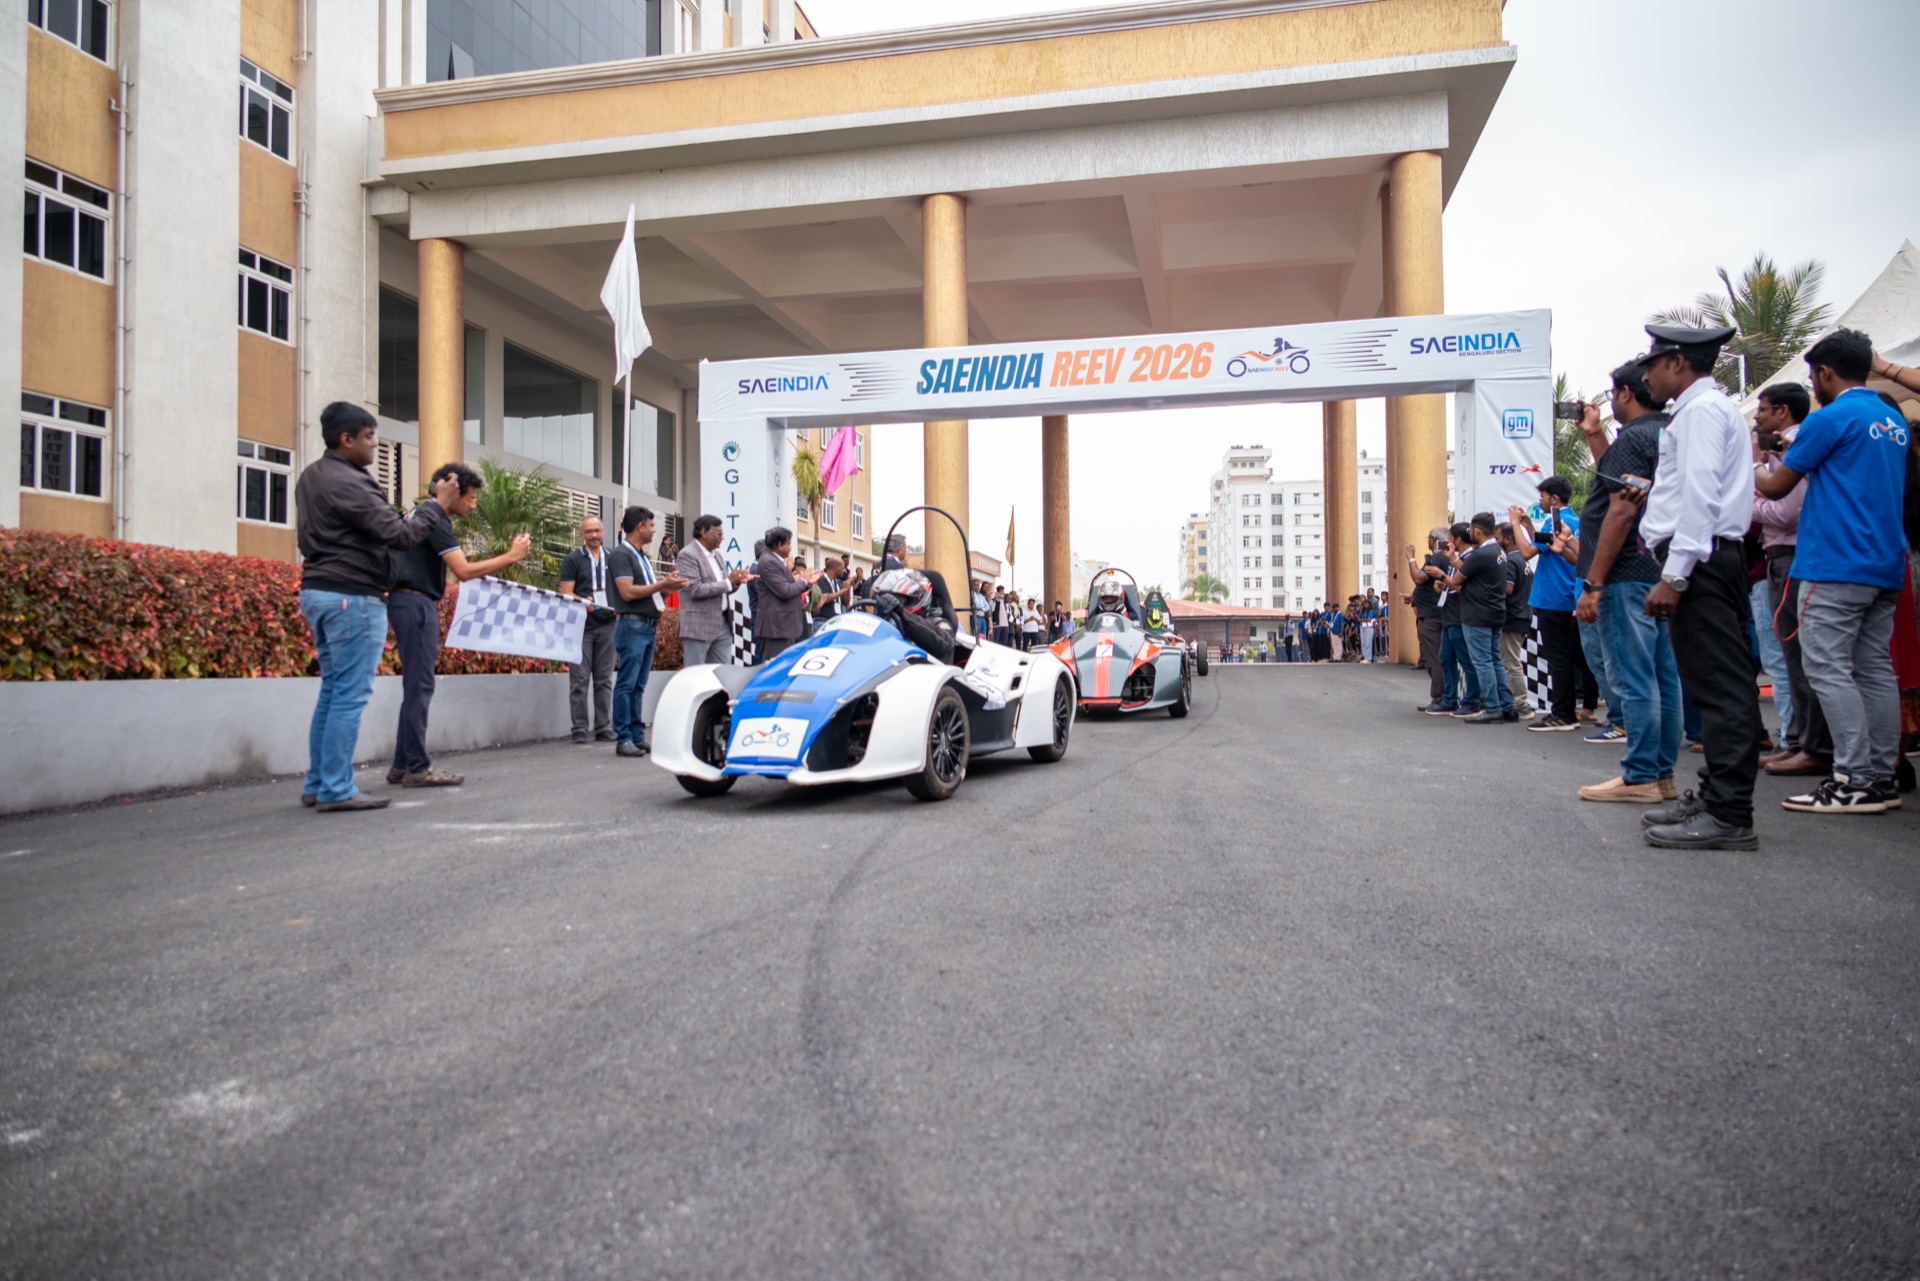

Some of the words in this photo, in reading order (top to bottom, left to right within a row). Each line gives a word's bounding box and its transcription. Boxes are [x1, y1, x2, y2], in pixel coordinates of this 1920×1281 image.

[1410, 332, 1520, 355] SAEINDIA
[1459, 349, 1495, 357] BENGALURU
[916, 352, 1044, 395] SAEINDIA
[1049, 347, 1126, 388] REEV
[1128, 341, 1214, 382] 2026
[738, 375, 829, 395] SAEINDIA
[1508, 416, 1528, 432] gm
[1489, 465, 1516, 475] TVS
[802, 655, 830, 671] 6
